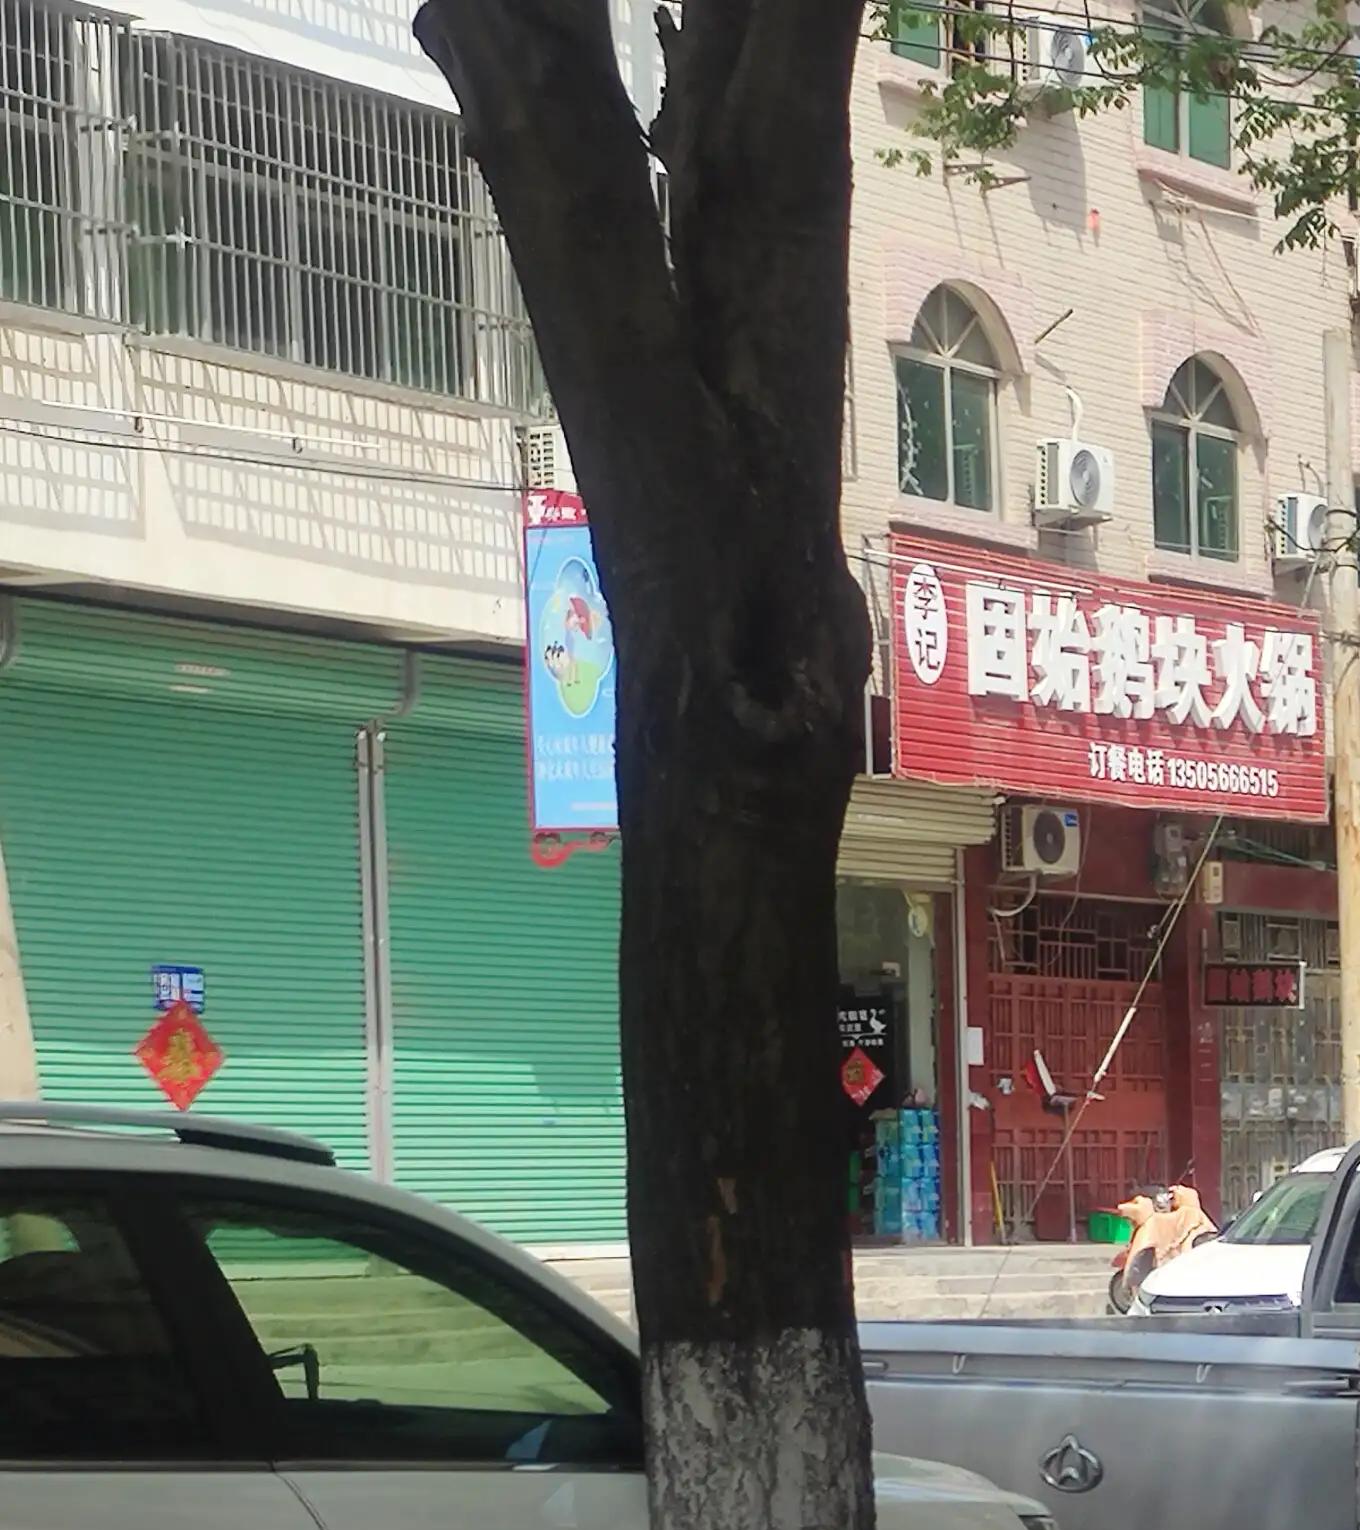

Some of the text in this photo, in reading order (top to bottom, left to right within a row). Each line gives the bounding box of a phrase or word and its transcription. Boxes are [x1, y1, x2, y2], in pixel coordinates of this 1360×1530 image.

[912, 578, 940, 670] 李记
[965, 580, 1317, 738] 固始鹅块火锅
